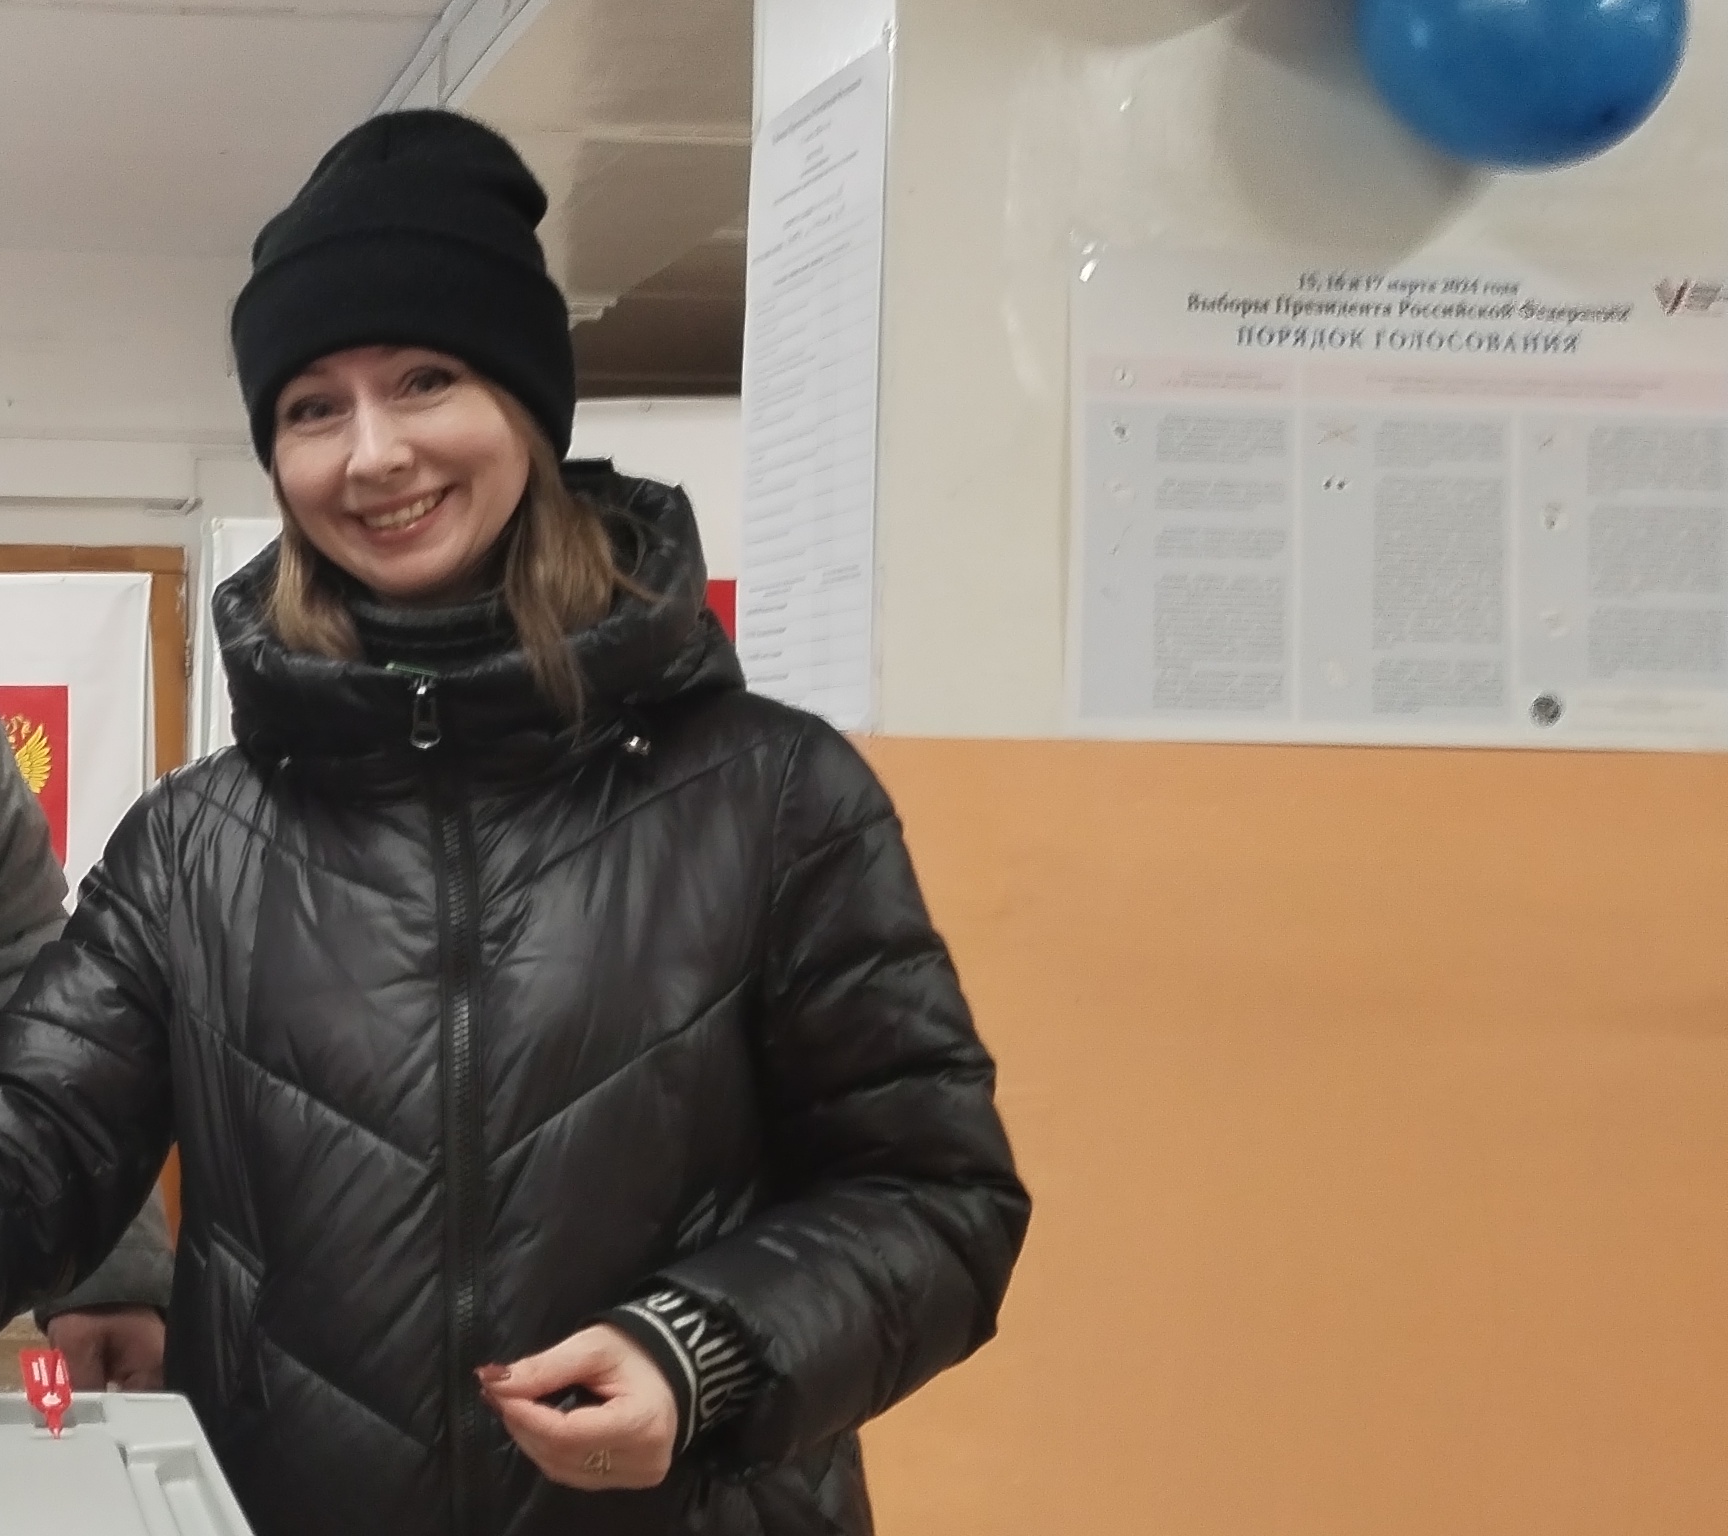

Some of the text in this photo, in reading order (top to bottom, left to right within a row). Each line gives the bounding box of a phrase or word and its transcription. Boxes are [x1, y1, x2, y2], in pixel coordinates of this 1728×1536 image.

[1186, 291, 1634, 326] Выборы Президента Российской Федерации
[1235, 323, 1583, 355] ПОРЯДОК ГОЛОСОВАНИЯ
